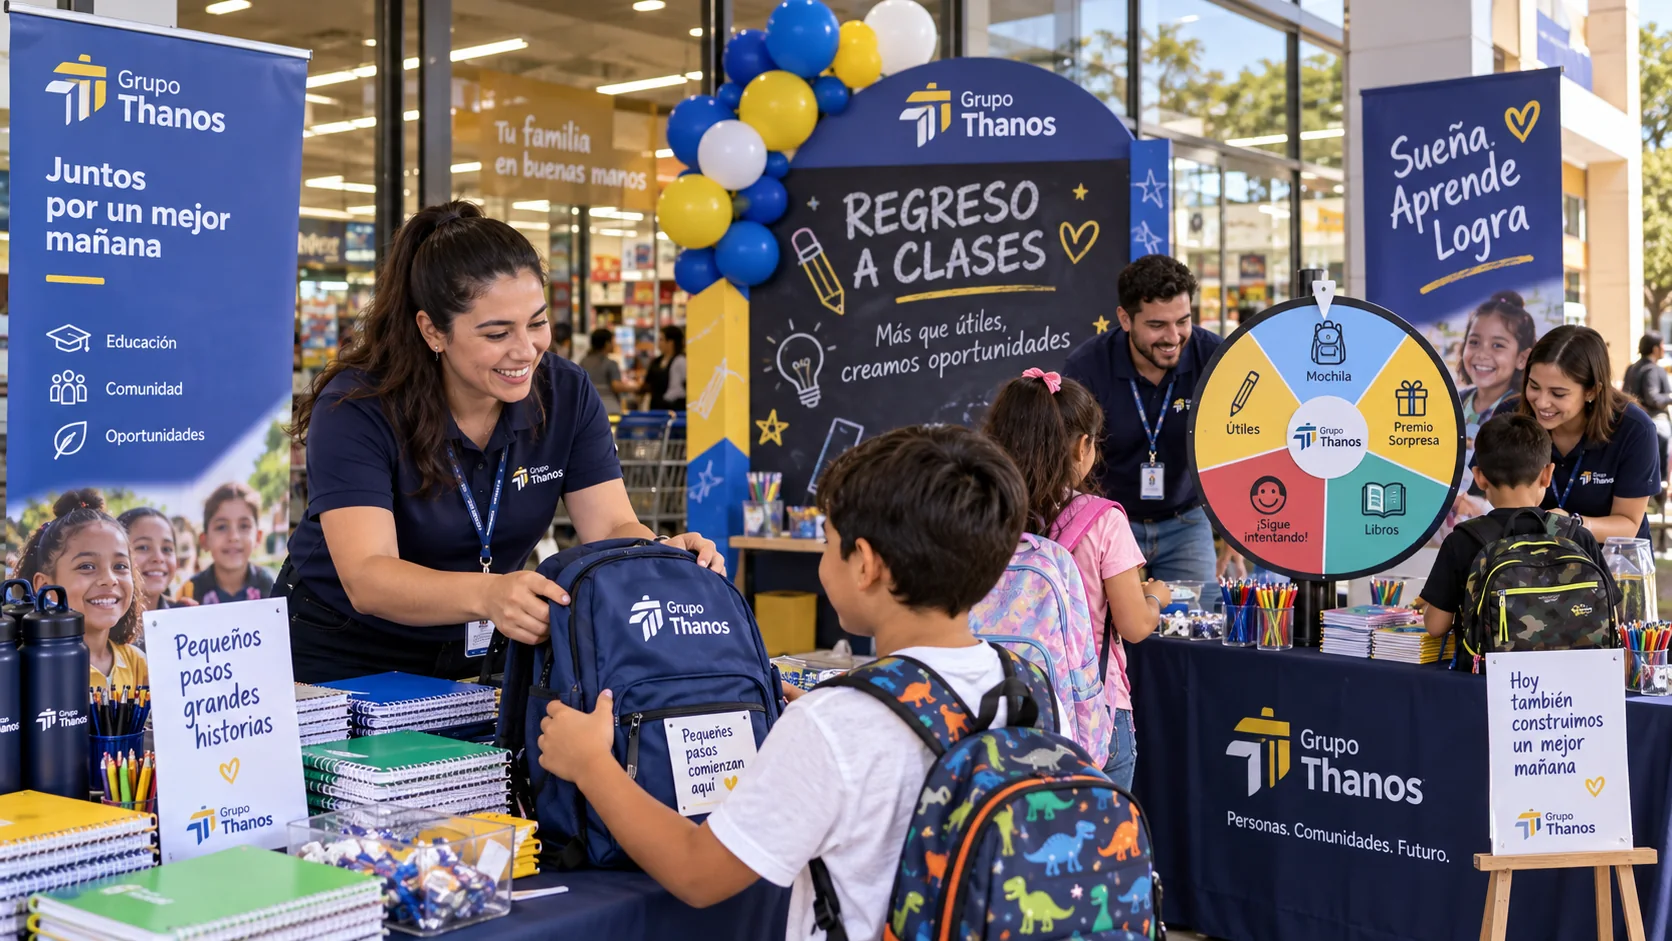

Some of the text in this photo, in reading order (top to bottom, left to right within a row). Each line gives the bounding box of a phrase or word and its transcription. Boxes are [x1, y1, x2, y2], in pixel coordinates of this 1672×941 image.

[118, 70, 180, 97] Grupo
[961, 91, 1013, 111] Grupo
[118, 94, 225, 132] Thanos
[494, 114, 591, 153] Tu familia
[962, 112, 1056, 137] Thanos
[46, 157, 146, 190] Juntos
[495, 150, 647, 191] en buenas manos
[1391, 150, 1521, 234] Aprende
[47, 197, 230, 235] por un mejor
[843, 179, 1040, 241] REGRESO
[47, 228, 161, 258] mañana
[1434, 205, 1530, 262] Logra
[854, 230, 1046, 288] A CLASES
[876, 309, 1006, 349] Más que útiles,
[107, 334, 176, 349] Educación
[842, 330, 1070, 382] creamos oportunidades
[1307, 371, 1351, 381] Mochila
[106, 382, 182, 395] Comunidad
[1227, 421, 1260, 434] Útiles
[1320, 427, 1343, 436] Grupo
[1394, 422, 1433, 432] Premio
[106, 428, 204, 446] Oportunidades
[1320, 436, 1361, 447] Thanos
[1389, 435, 1439, 448] Sorpresa
[531, 469, 563, 484] Thanos
[1257, 519, 1290, 532] ¡Sigue
[1365, 524, 1399, 535] Libros
[1245, 532, 1308, 542] intentando!
[667, 601, 704, 617] Grupo
[669, 616, 730, 634] Thanos
[174, 628, 261, 663] Pequeños
[180, 663, 232, 697] pasos
[1510, 671, 1539, 694] Hoy
[184, 682, 260, 729] grandes
[1511, 691, 1572, 710] también
[59, 716, 87, 727] Thanos
[1512, 713, 1603, 731] construimos
[196, 716, 272, 749] historias
[1301, 729, 1358, 758] Grupo
[1514, 734, 1585, 758] un mejor
[686, 746, 718, 764] pasos
[689, 760, 744, 777] comienzan
[1515, 758, 1576, 776] mañana
[692, 777, 715, 797] aquí
[1301, 756, 1423, 804] Thanos
[220, 806, 250, 817] Grupo
[1546, 812, 1573, 822] Grupo
[221, 815, 273, 834] Thanos
[1546, 822, 1595, 835] Thanos
[1228, 811, 1449, 862] Personas. Comunidades. Futuro.
